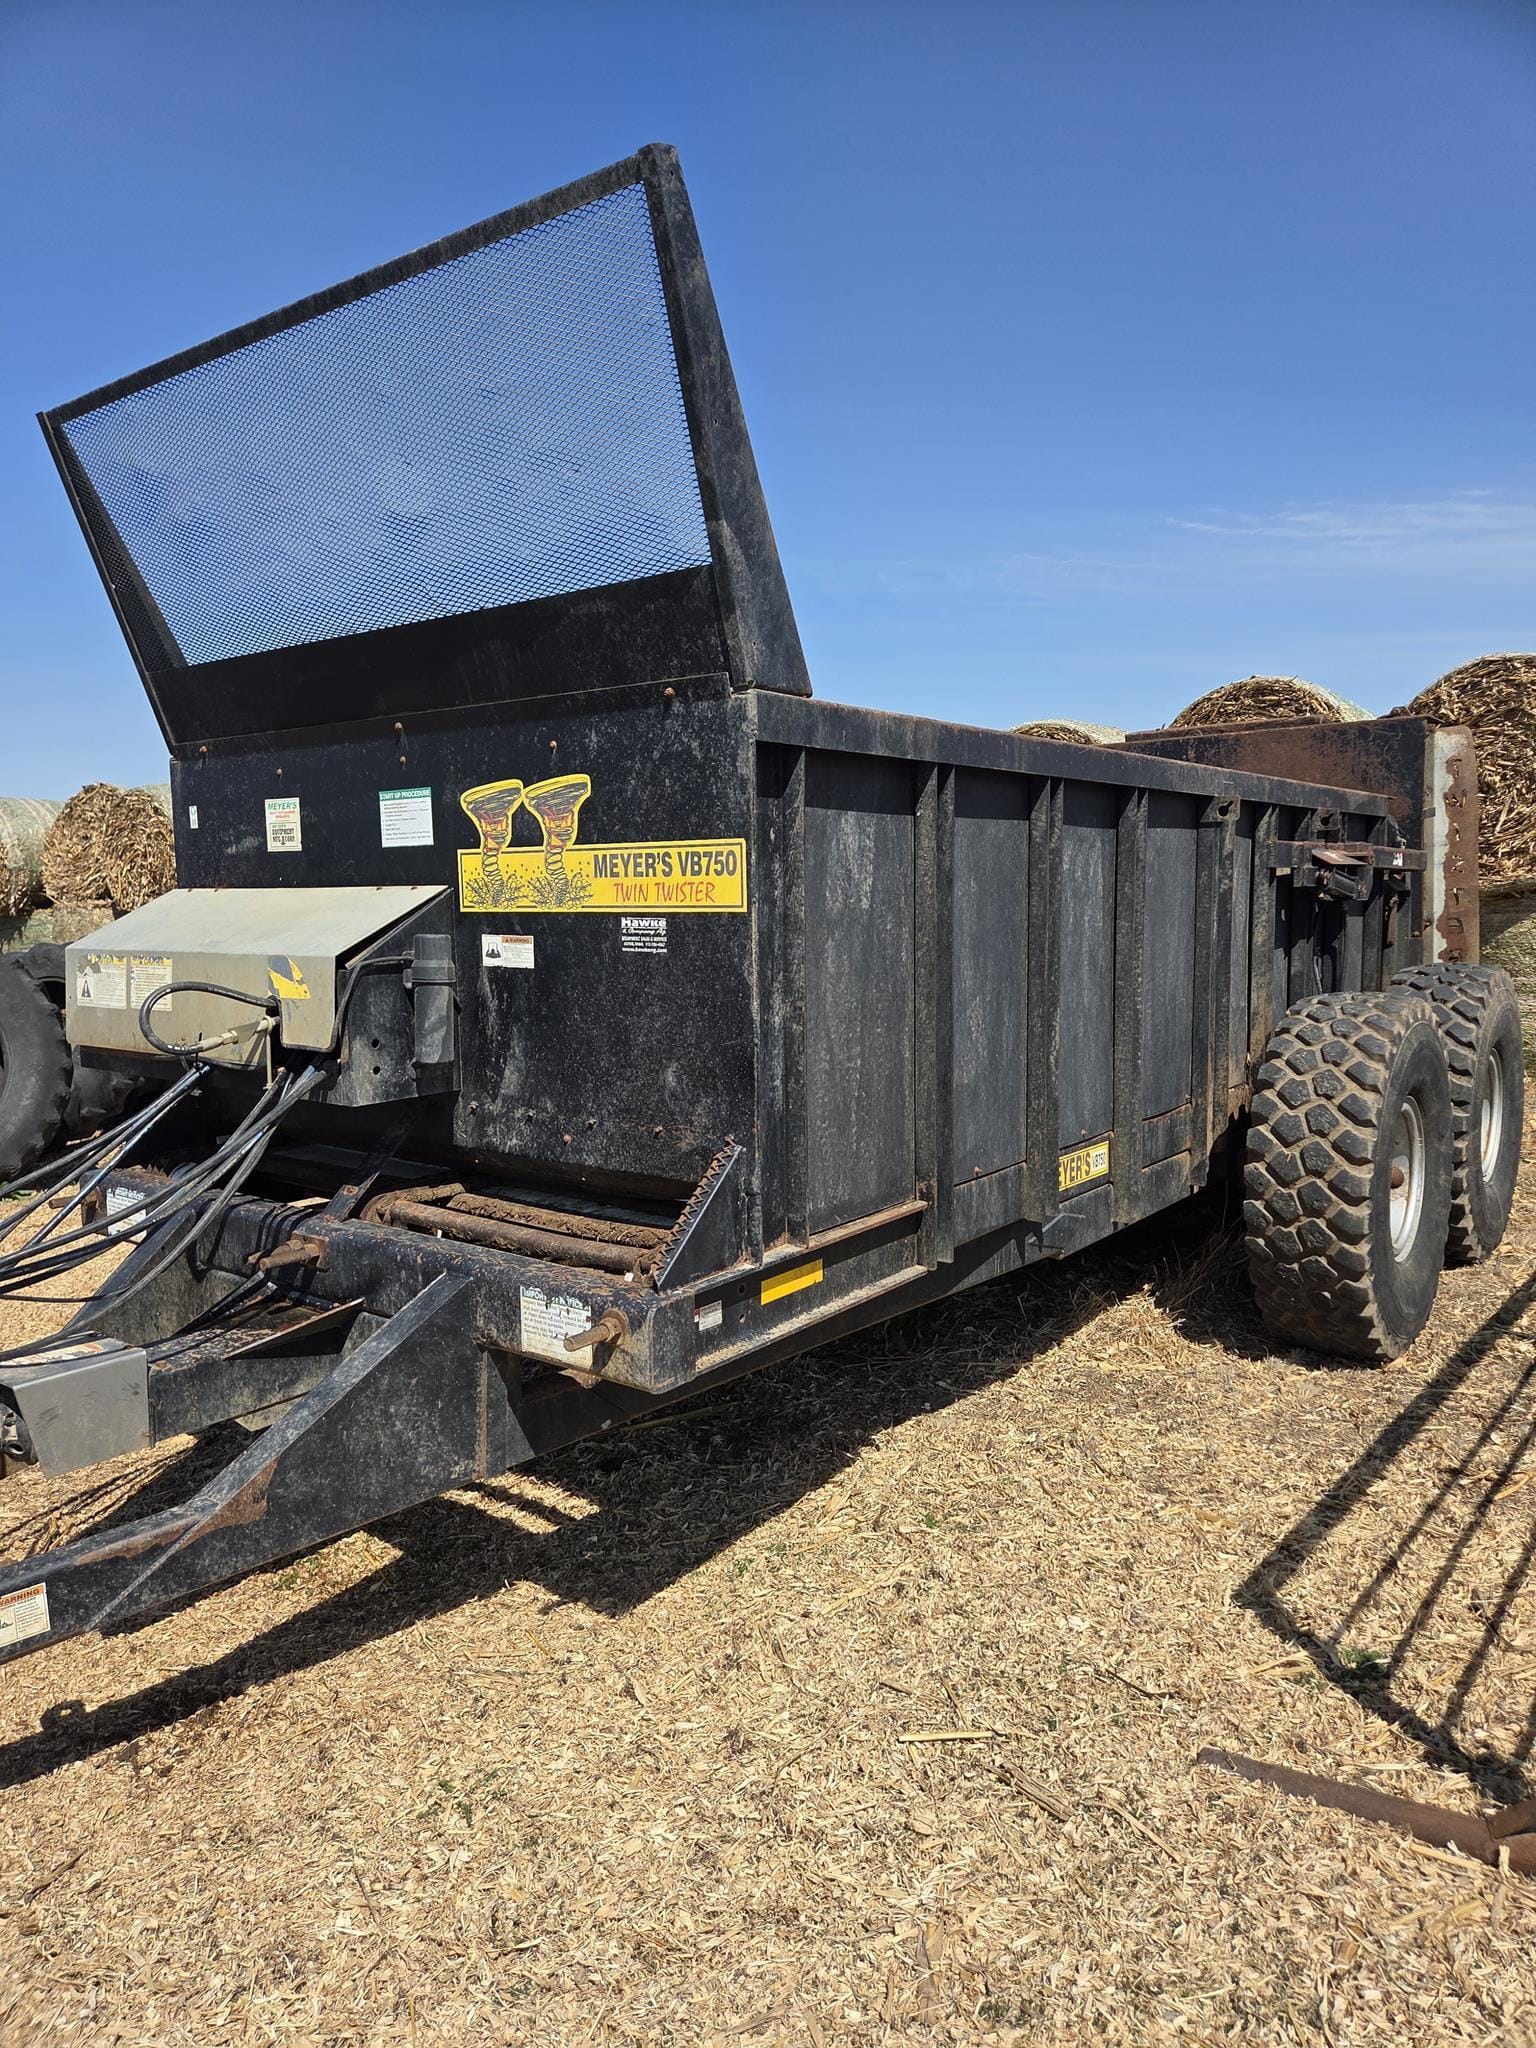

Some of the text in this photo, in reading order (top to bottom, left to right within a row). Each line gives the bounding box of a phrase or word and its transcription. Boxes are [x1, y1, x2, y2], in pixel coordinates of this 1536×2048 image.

[379, 792, 393, 800] START
[401, 790, 430, 798] PROCEDURE
[267, 801, 297, 810] MEYER'S
[593, 850, 737, 879] MEYER'S VB750
[613, 881, 716, 903] TWIN TWISTER
[621, 917, 667, 928] Hawke
[1058, 1152, 1091, 1186] EYER'S
